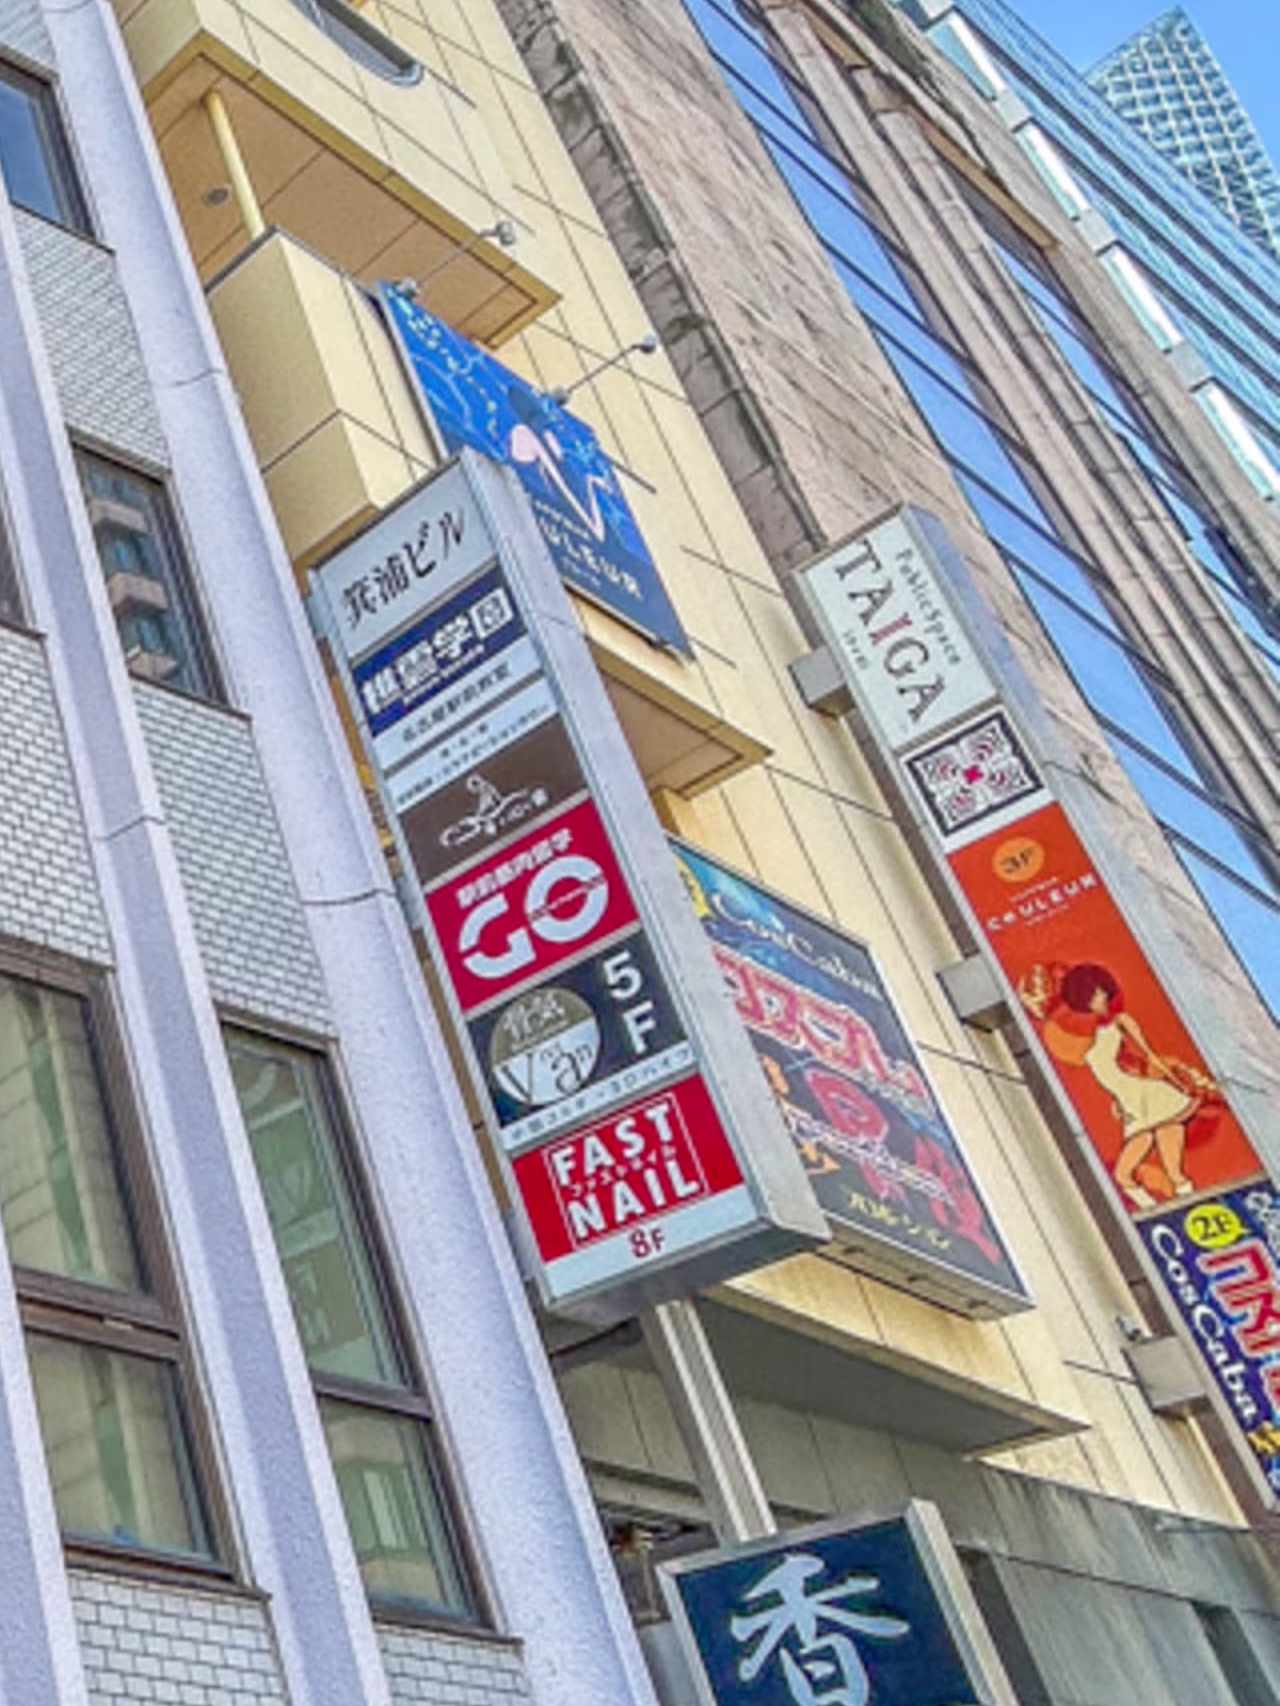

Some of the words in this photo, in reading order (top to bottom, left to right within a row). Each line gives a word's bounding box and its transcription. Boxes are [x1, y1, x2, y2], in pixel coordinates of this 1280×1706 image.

[343, 507, 464, 629] 箕浦ビル
[834, 537, 947, 724] TAIGA
[458, 854, 609, 979] GO
[551, 1104, 672, 1185] FAST
[567, 1160, 700, 1238] NAIL
[1191, 1214, 1235, 1242] 2F
[628, 1227, 666, 1259] 8F
